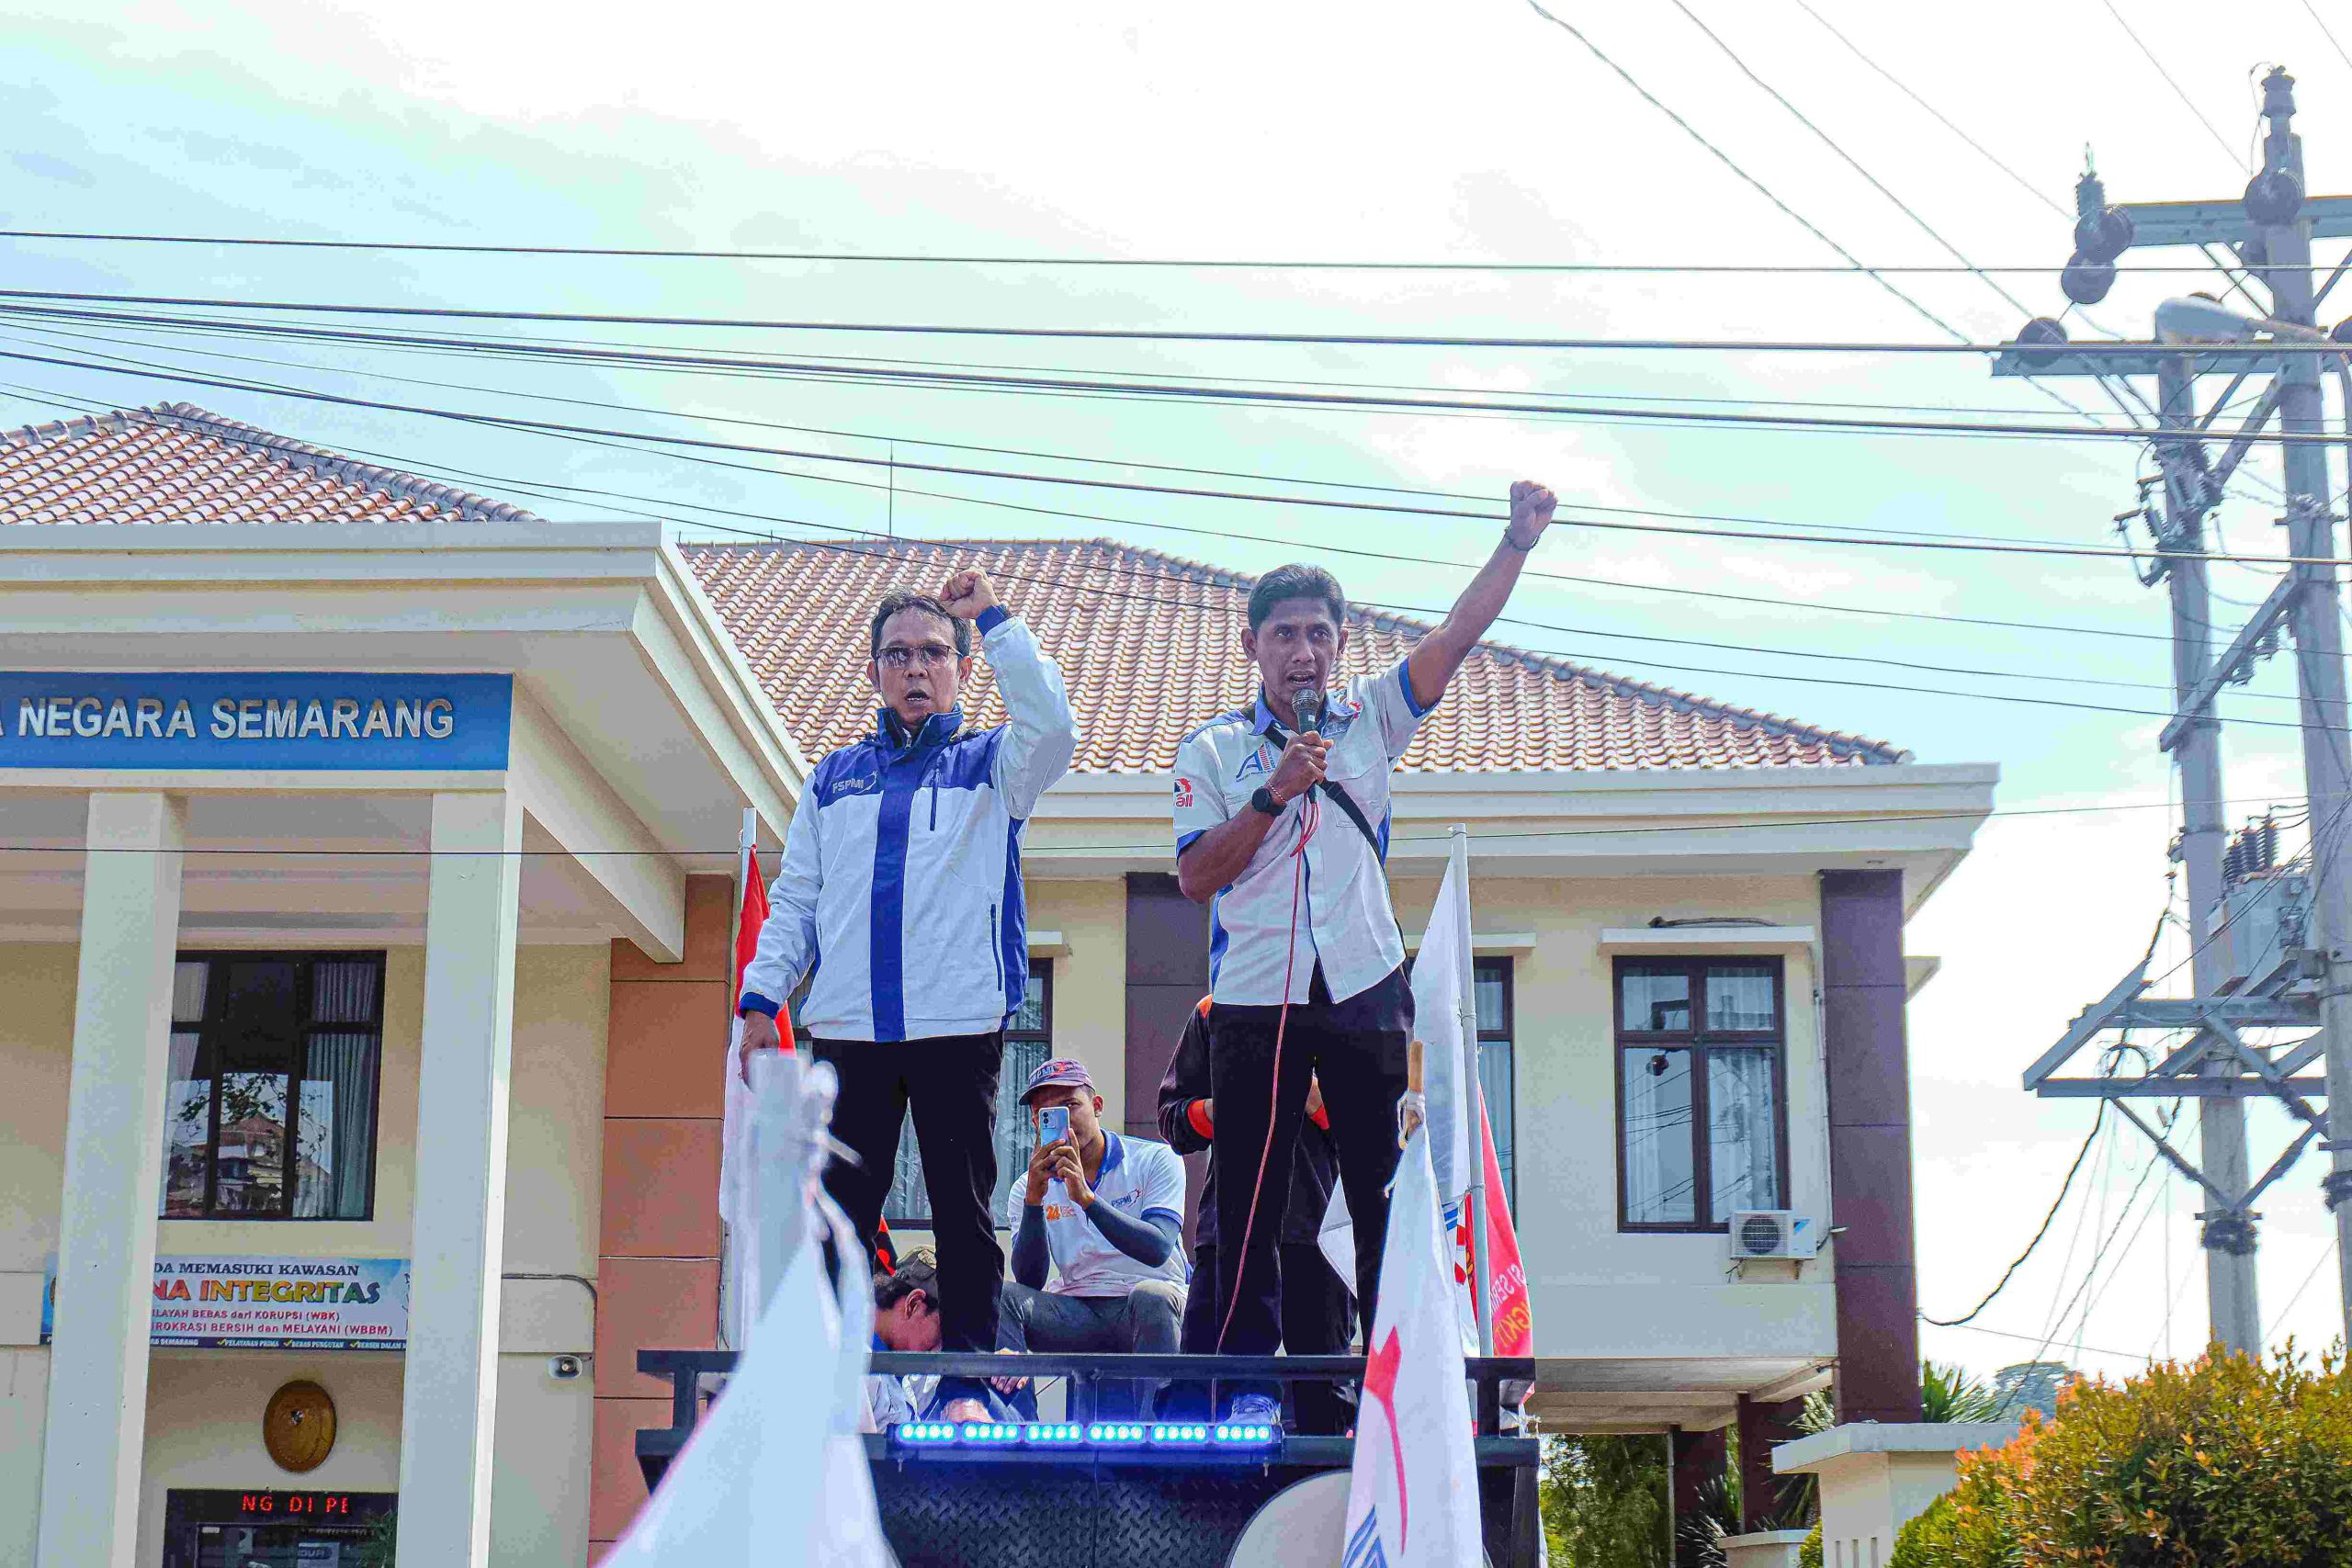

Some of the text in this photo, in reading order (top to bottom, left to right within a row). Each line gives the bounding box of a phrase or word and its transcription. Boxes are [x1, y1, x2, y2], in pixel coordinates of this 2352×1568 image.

[18, 697, 196, 739] NEGARA
[209, 698, 454, 739] SEMARANG
[832, 778, 865, 794] FSPMI
[179, 1263, 273, 1275] MEMASUKI
[278, 1264, 359, 1276] KAWASAN
[199, 1280, 380, 1303] INTEGRITAS
[192, 1310, 228, 1319] BEBAS
[231, 1311, 251, 1319] dari
[254, 1311, 302, 1320] KORUPSI
[307, 1311, 340, 1322] (WBK)
[211, 1323, 254, 1333] BERSIH
[257, 1324, 278, 1333] dan
[283, 1325, 340, 1334] MELAYANI
[345, 1325, 392, 1336] (WBBM)
[242, 1495, 273, 1511] NG
[289, 1496, 312, 1513] DI
